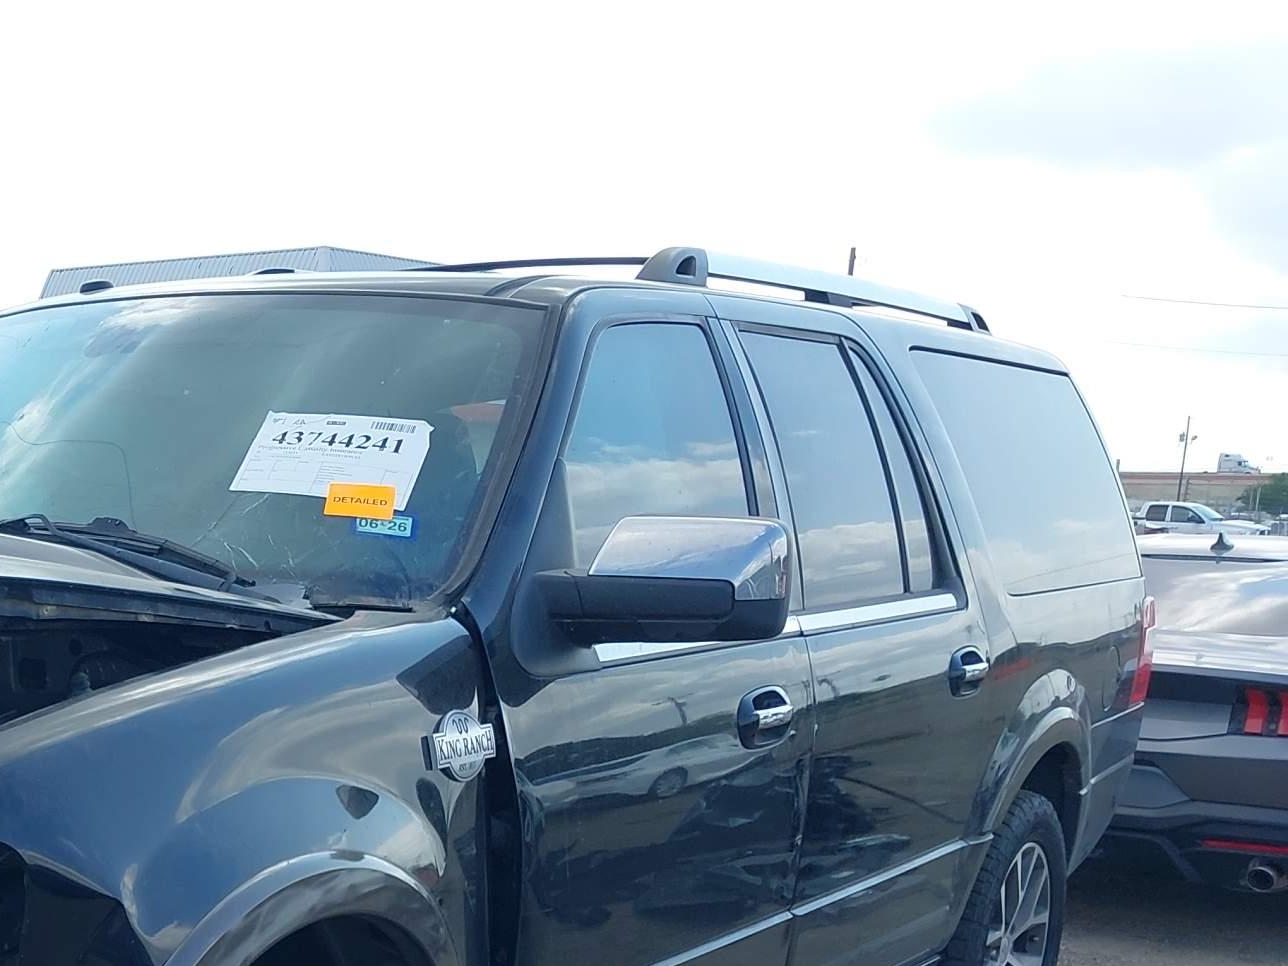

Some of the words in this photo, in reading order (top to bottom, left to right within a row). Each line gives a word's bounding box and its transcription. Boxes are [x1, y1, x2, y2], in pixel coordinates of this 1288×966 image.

[272, 430, 404, 454] 43744241
[333, 496, 388, 506] DETAILED
[358, 518, 379, 529] 06
[387, 521, 407, 532] 26
[438, 738, 462, 760] KING
[463, 730, 494, 756] RANCH
